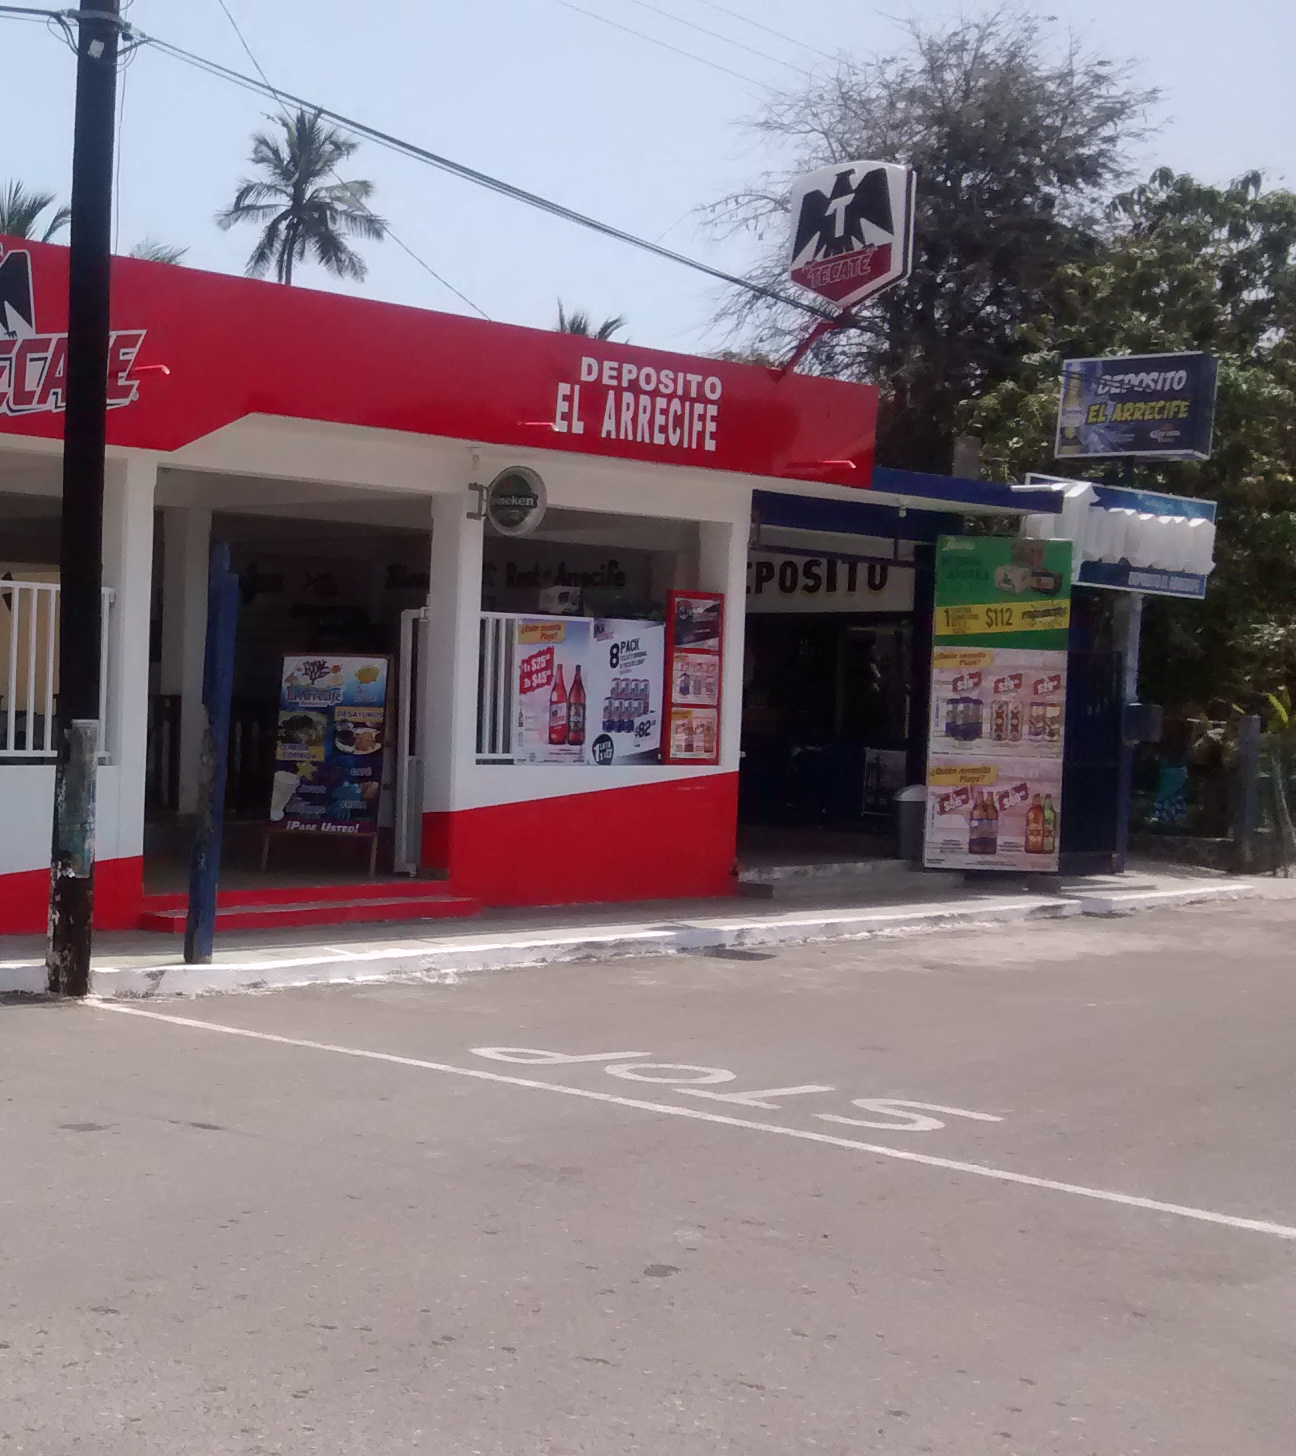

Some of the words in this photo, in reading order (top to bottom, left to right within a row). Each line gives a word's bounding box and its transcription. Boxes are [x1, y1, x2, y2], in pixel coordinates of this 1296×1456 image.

[805, 252, 875, 289] TECATE
[580, 356, 723, 401] DEPOSITO
[1096, 369, 1188, 397] DEPOSITO
[554, 382, 585, 434] EL
[600, 389, 719, 452] ARRECIFE
[1087, 403, 1108, 424] EL
[1111, 400, 1191, 422] ARRECIFE
[609, 643, 620, 669] 8
[620, 637, 641, 655] PACK
